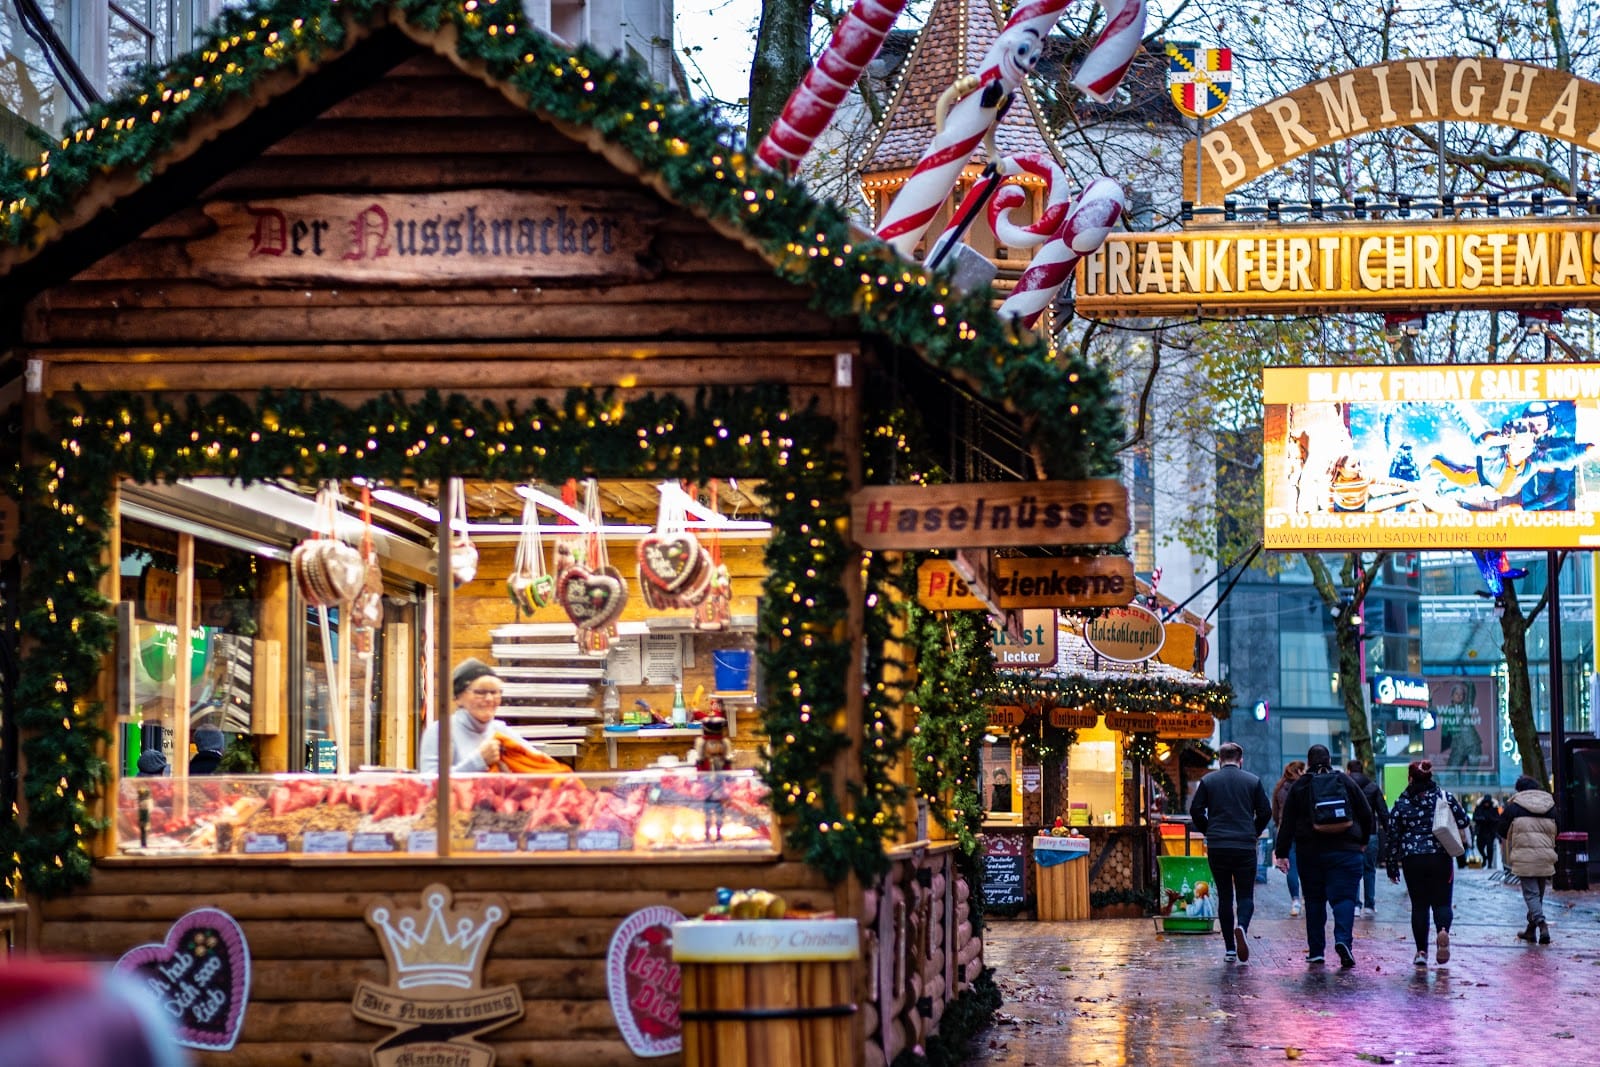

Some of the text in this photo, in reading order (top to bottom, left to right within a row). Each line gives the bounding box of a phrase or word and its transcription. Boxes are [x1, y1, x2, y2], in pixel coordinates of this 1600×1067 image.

[1201, 58, 1600, 188] BIRMINGHA
[248, 203, 619, 261] Der Nussknacker
[1088, 236, 1340, 294] FRANKFURT
[1308, 367, 1600, 401] BLACK FRIDAY SALE NOW
[865, 497, 1114, 533] Haselnüsse
[1266, 513, 1288, 529] UP
[1289, 513, 1309, 529] TO
[1344, 512, 1376, 528] OFF
[1377, 512, 1438, 528] TICKETS
[1439, 511, 1474, 528] AND
[1475, 511, 1509, 527] GIFT
[1509, 511, 1595, 527] VOUCHERS
[1267, 532, 1508, 545] WWW.BEARGRYLLSADVENTURE.COM
[928, 568, 1125, 597] Piszienkerne
[1091, 621, 1160, 651] Holzkohlengrill
[1003, 651, 1041, 662] lecker
[1436, 704, 1480, 715] Walk in
[1462, 716, 1482, 725] out
[733, 928, 784, 953] Merry
[159, 951, 193, 983] hab
[628, 947, 667, 985] Ich
[163, 981, 200, 1018] Dich
[191, 989, 226, 1023] lieb
